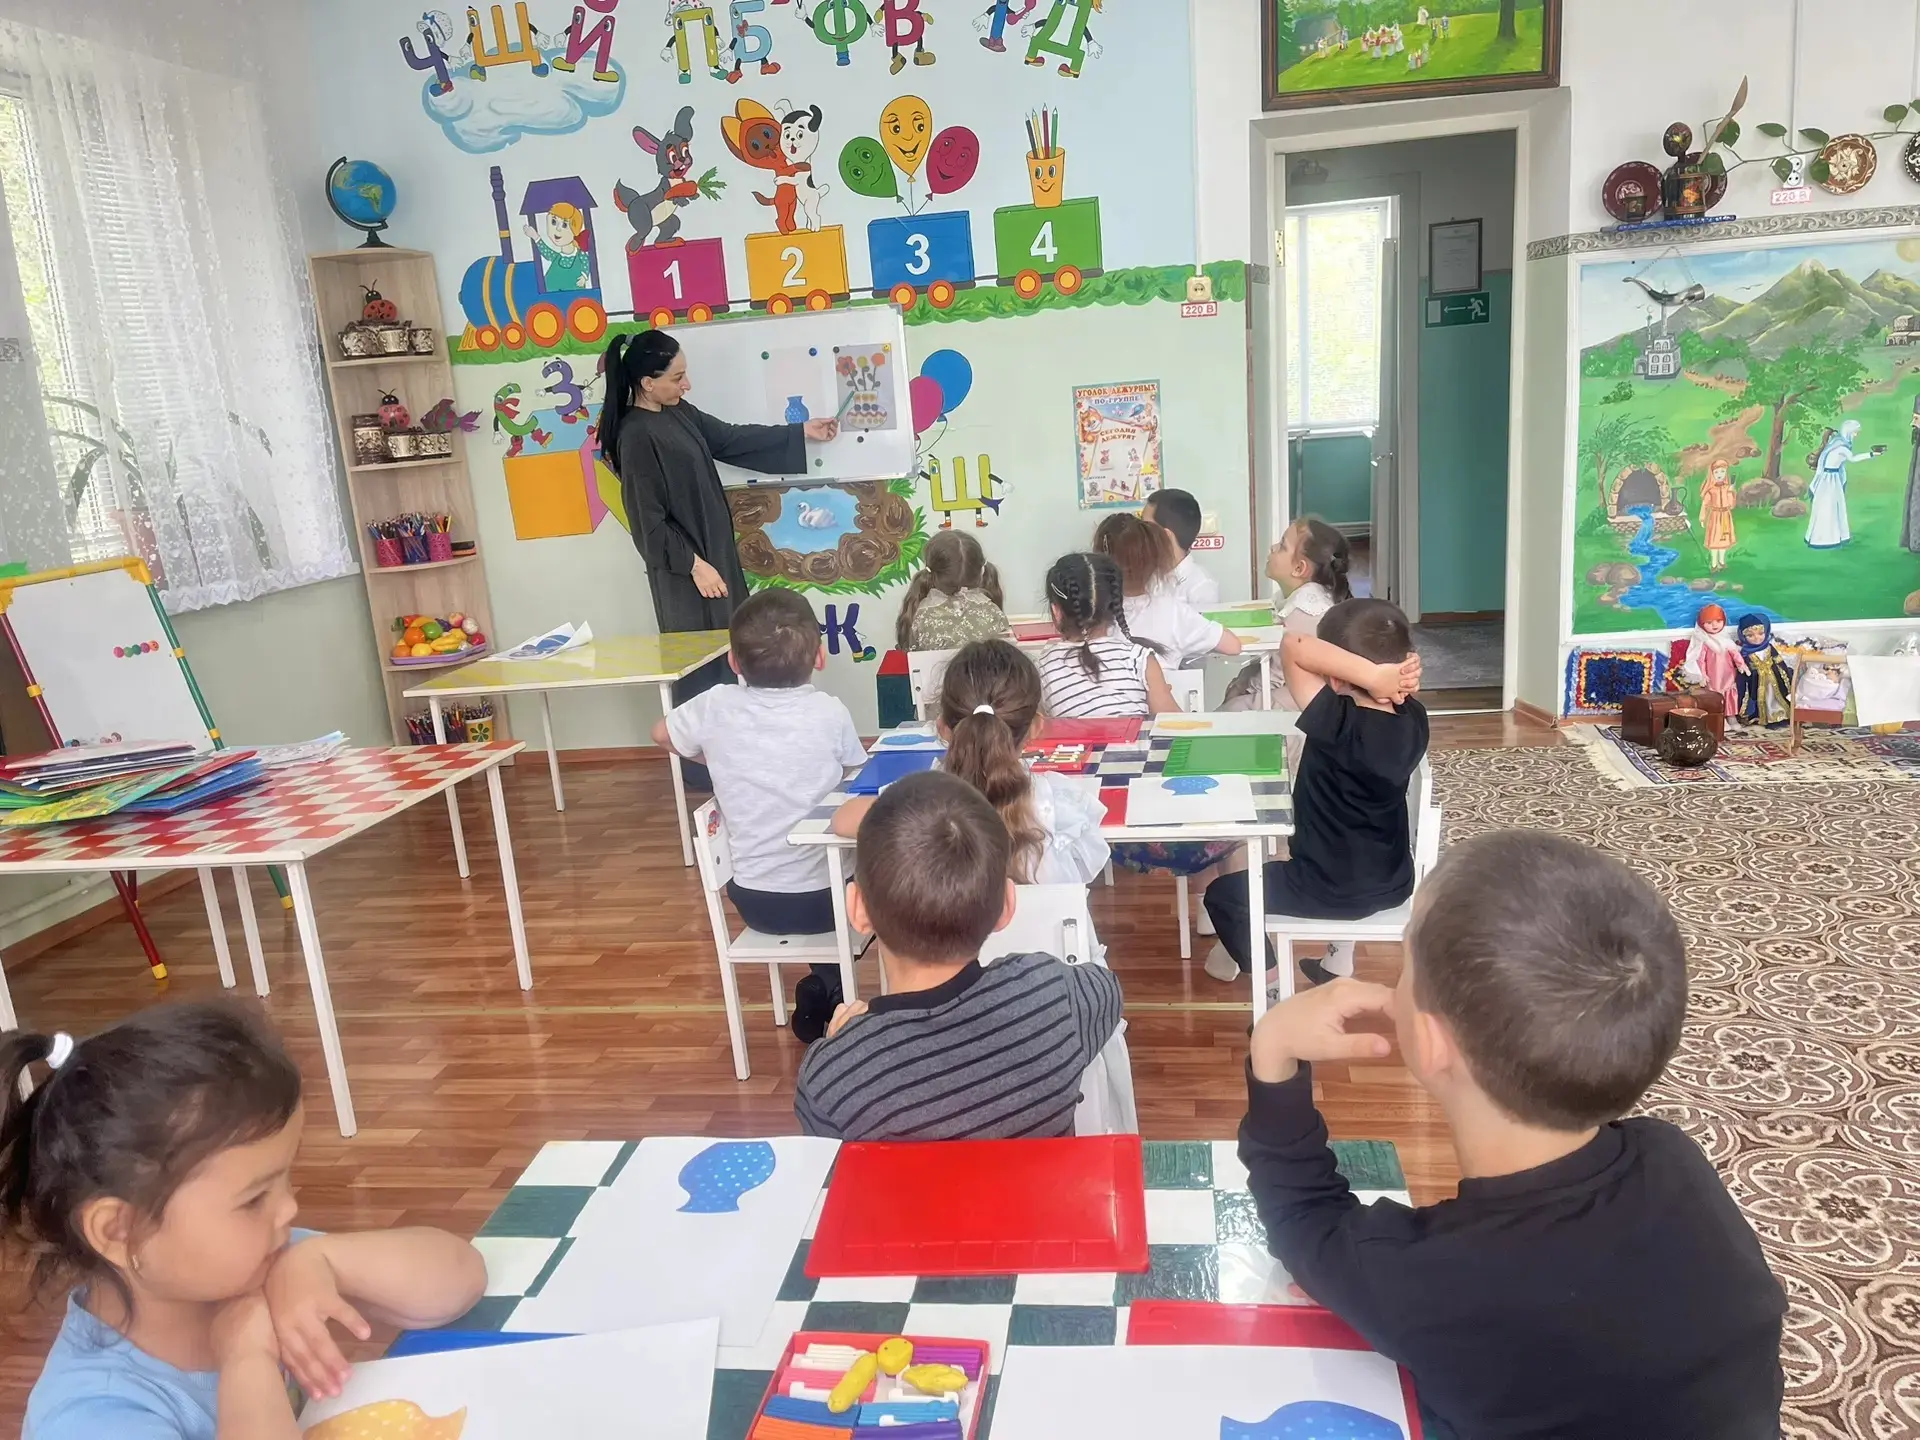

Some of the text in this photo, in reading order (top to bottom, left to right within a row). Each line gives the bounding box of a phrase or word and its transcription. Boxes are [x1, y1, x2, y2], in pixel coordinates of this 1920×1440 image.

[466, 2, 540, 67] Щ
[1775, 191, 1796, 202] 220
[904, 234, 931, 275] 3
[1029, 221, 1058, 263] 4
[662, 260, 684, 299] 1
[779, 247, 808, 288] 2
[1185, 305, 1203, 314] 220
[1077, 384, 1156, 397] УГОЛОК ДЕЖУРНЫХ
[1100, 428, 1136, 436] СЕГОДНЯ
[1194, 539, 1211, 547] 220
